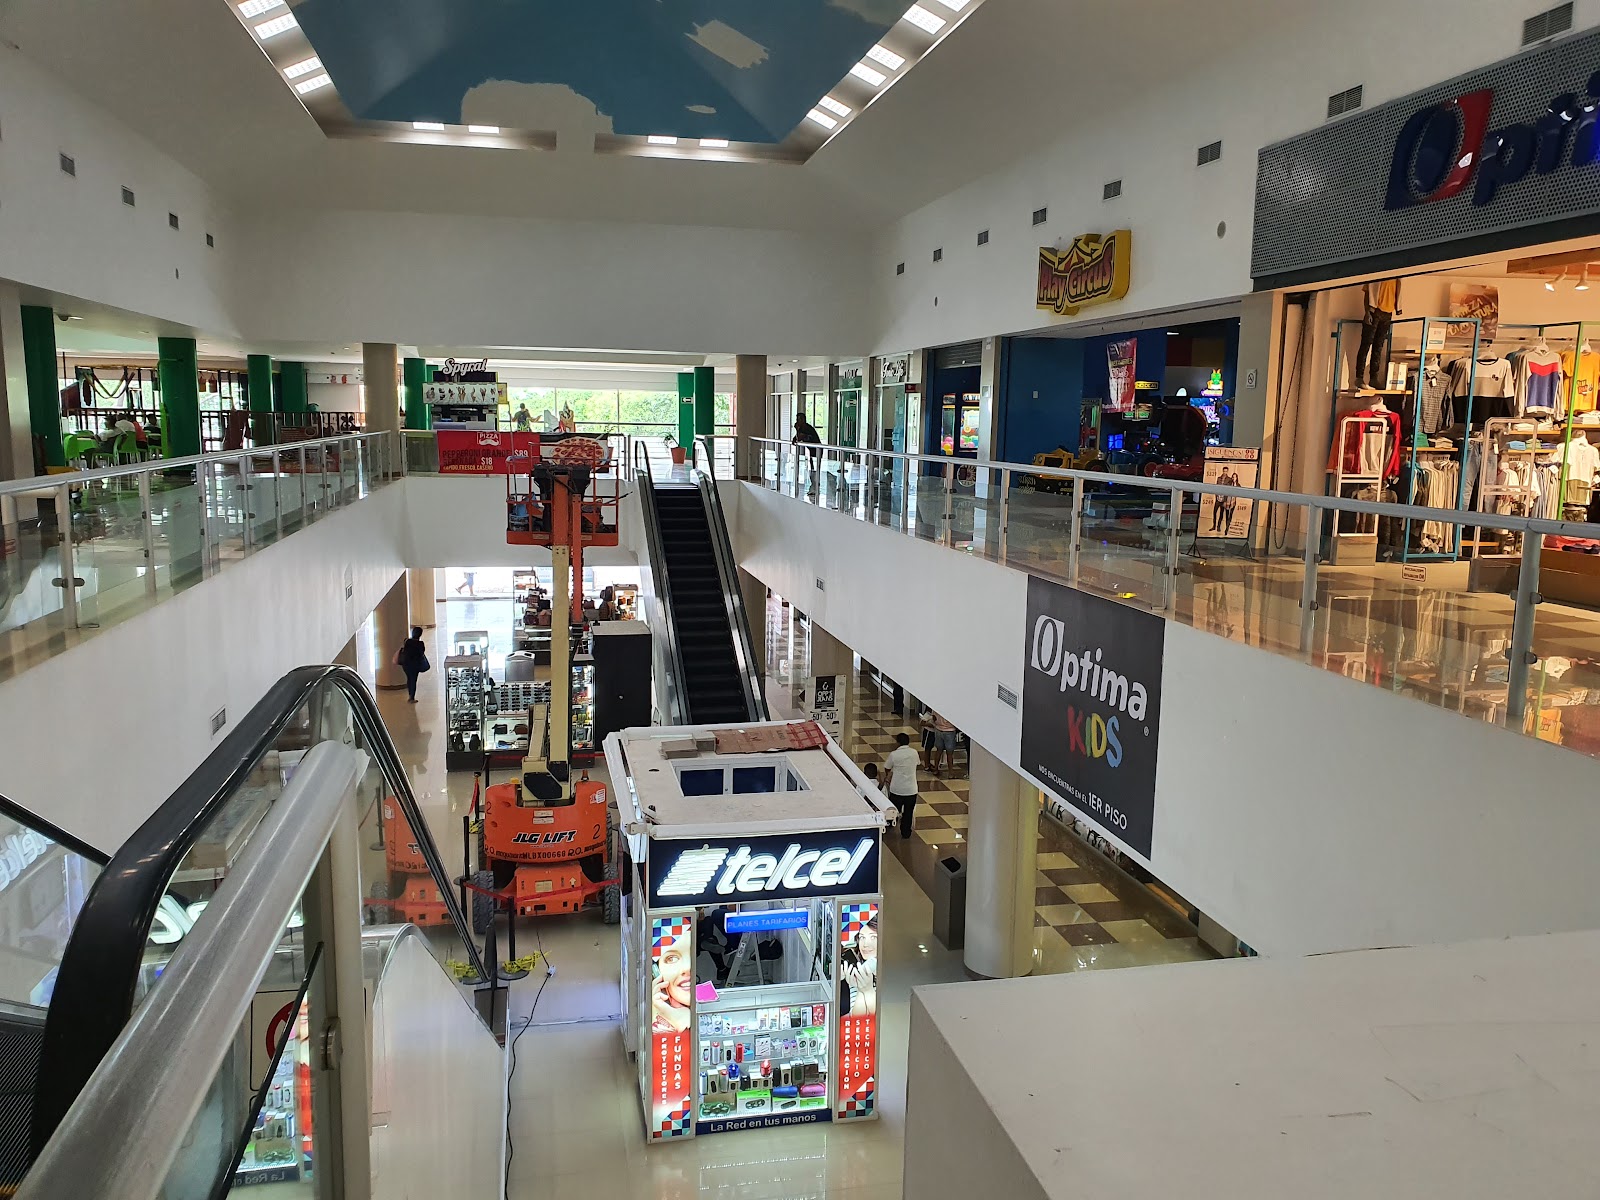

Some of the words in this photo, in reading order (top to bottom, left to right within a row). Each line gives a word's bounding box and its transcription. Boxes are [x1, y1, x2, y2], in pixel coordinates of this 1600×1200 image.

[1040, 260, 1066, 306] Play
[1068, 242, 1114, 297] Circus
[442, 358, 488, 377] Spyral
[443, 449, 481, 458] PEPPERONI
[481, 457, 493, 465] $18
[1031, 614, 1148, 721] Optima
[1067, 704, 1123, 767] KIDS
[1038, 764, 1048, 775] NOS
[1047, 770, 1075, 795] ENCUENTRAS
[1075, 789, 1082, 799] EN
[1081, 794, 1088, 804] EL
[1088, 792, 1103, 813] 1ER
[1104, 803, 1127, 830] PISO
[486, 801, 492, 814] 2
[512, 832, 541, 844] JLG
[542, 830, 577, 843] LIFT
[592, 824, 600, 839] 2
[716, 837, 875, 895] telcel
[728, 919, 759, 928] PLANES
[761, 916, 807, 926] TARIFARIOS
[674, 1036, 682, 1090] FUNDAS
[843, 1020, 851, 1090] REPARACION
[710, 1123, 723, 1132] La
[726, 1120, 747, 1130] Red
[748, 1120, 761, 1128] en
[764, 1118, 780, 1126] tus
[782, 1114, 817, 1124] manos
